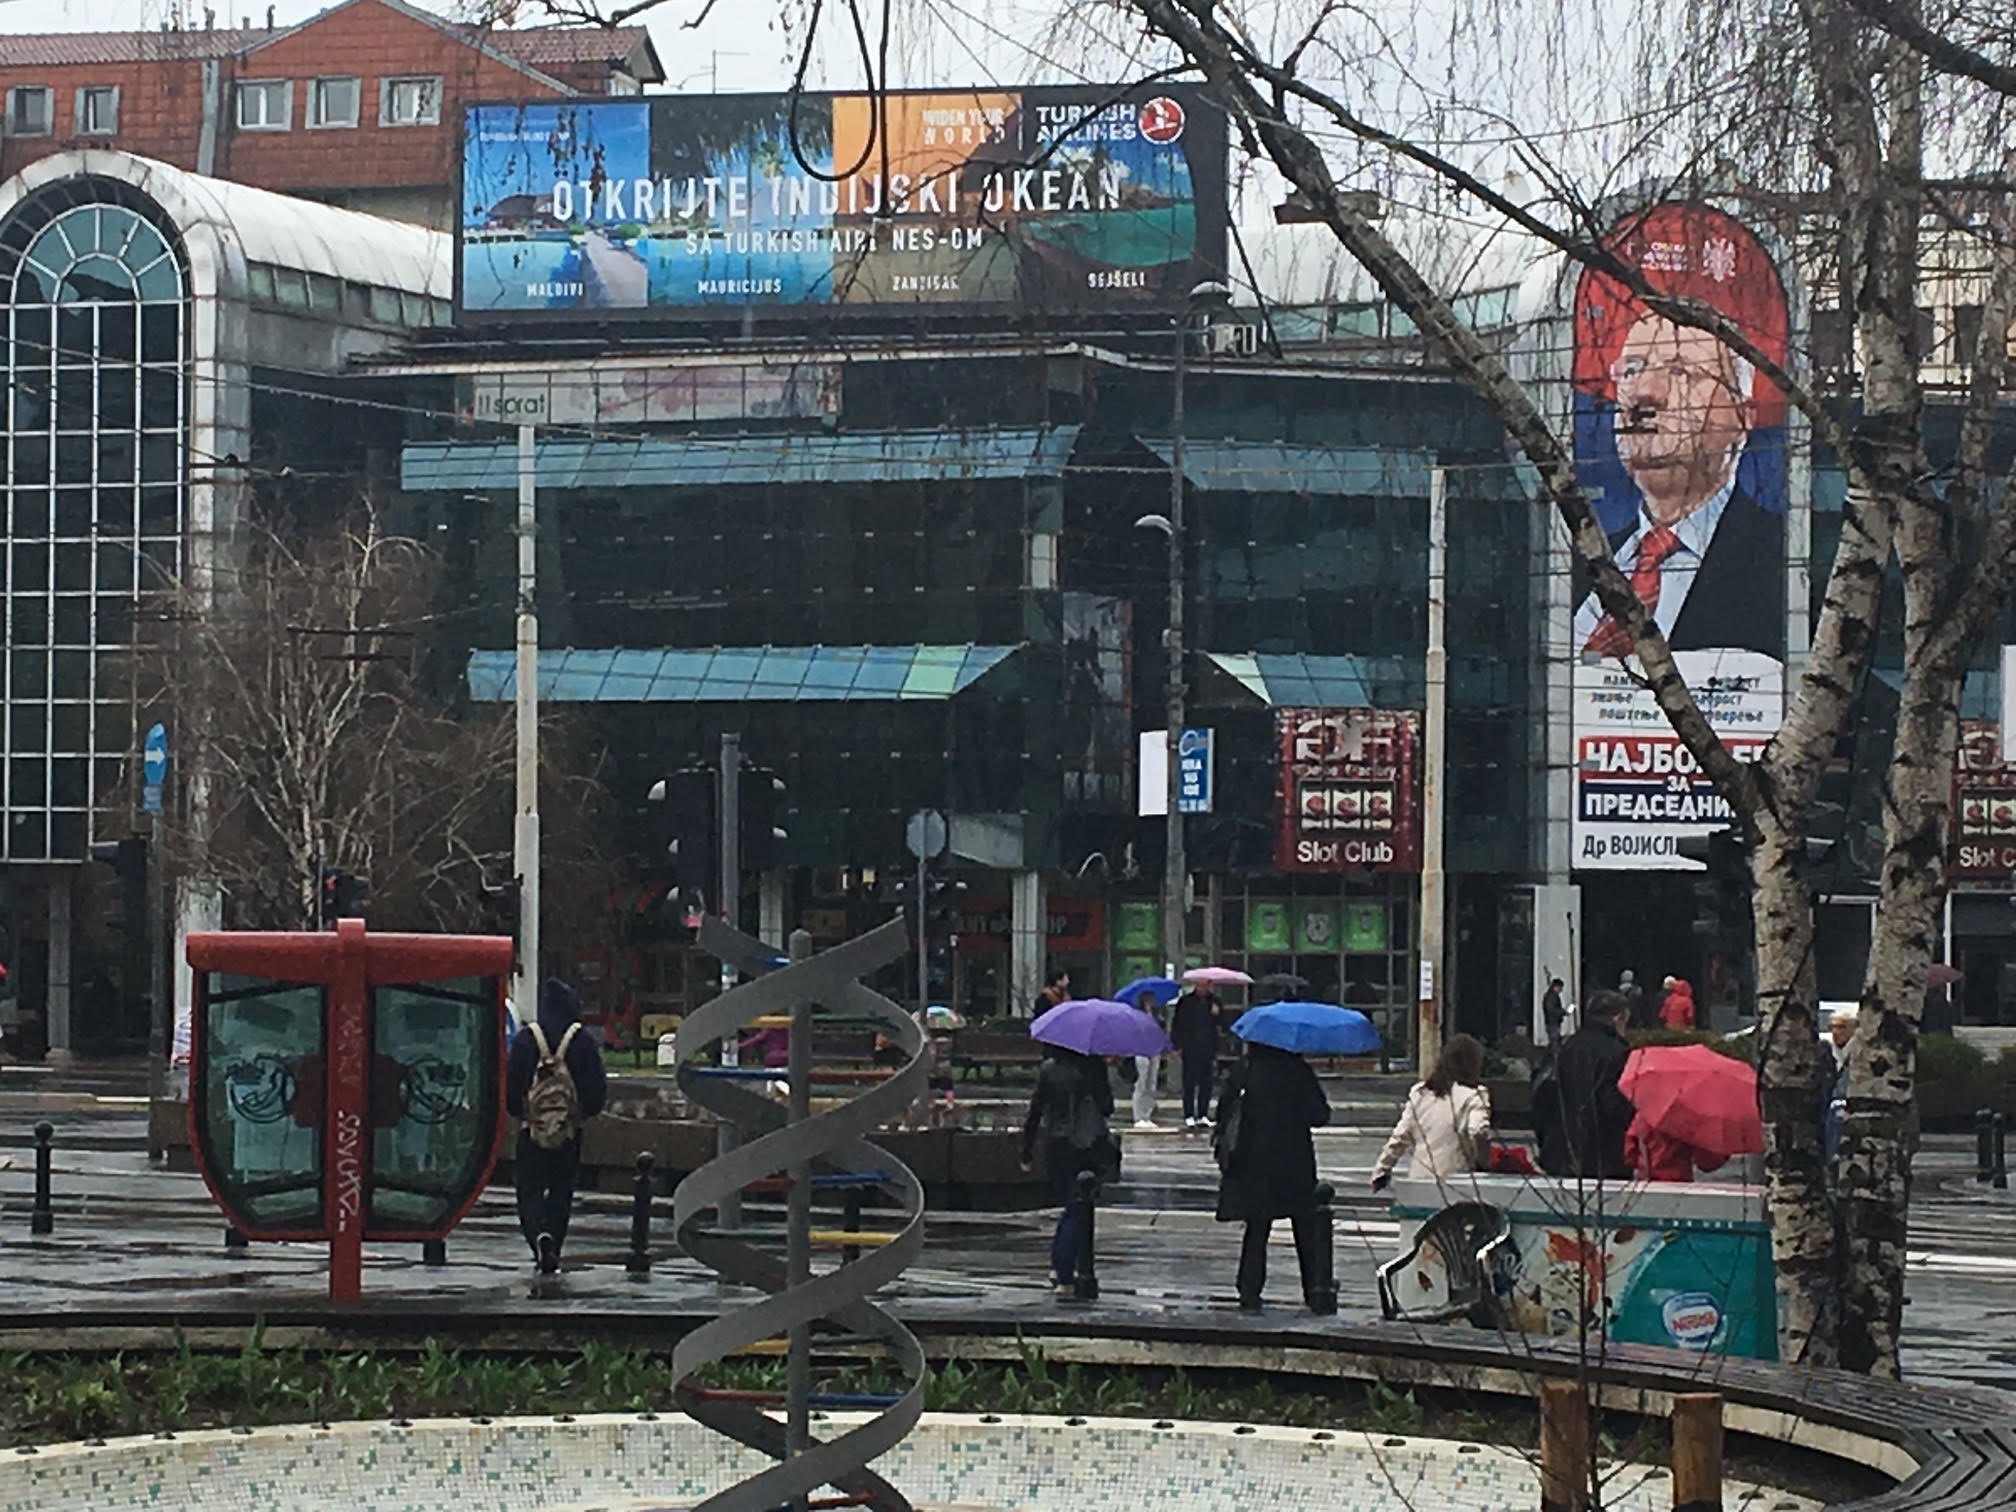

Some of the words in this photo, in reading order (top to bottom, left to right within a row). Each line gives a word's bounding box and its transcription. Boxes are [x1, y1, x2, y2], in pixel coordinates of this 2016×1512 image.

[923, 108, 966, 126] WIDEN
[553, 175, 748, 222] OTKRIJTE
[771, 170, 957, 217] INDIJSKI
[982, 167, 1120, 213] OKEAN
[686, 231, 713, 256] SA
[724, 231, 819, 255] TURKISH
[525, 282, 585, 298] MALDIVI
[697, 278, 783, 295] MAURICIJUS
[1666, 776, 1691, 793] ЗА
[1586, 793, 1738, 822] ПРЕДСЕДНИ
[1297, 841, 1338, 863] Slot
[1345, 841, 1394, 863] Club
[1582, 834, 1607, 859] Др
[1610, 835, 1679, 856] ВОЈИСЛ
[1959, 846, 1995, 868] Slot
